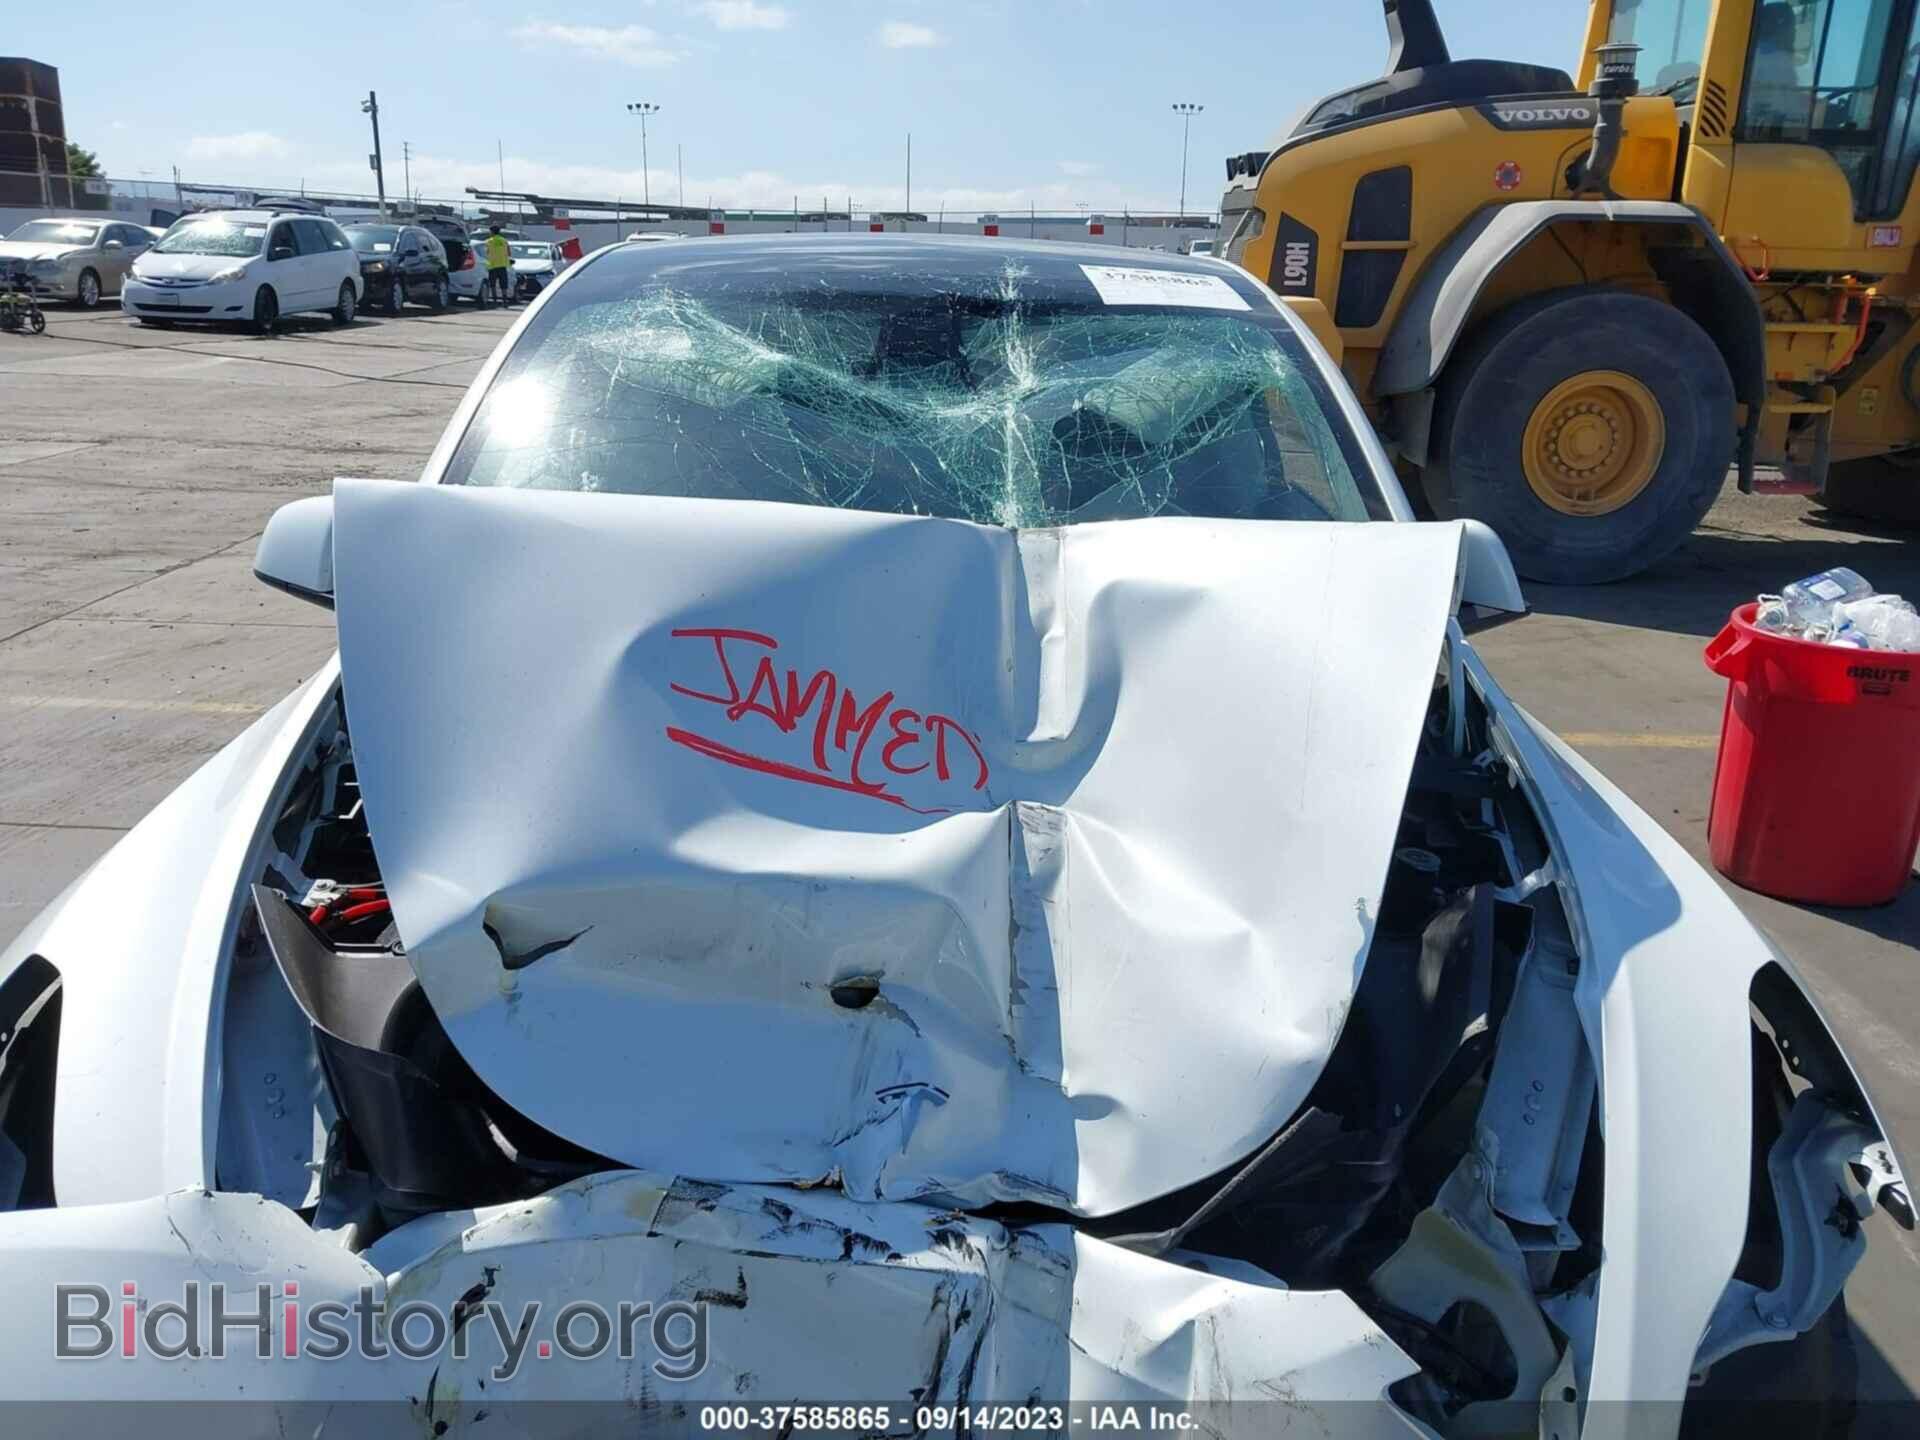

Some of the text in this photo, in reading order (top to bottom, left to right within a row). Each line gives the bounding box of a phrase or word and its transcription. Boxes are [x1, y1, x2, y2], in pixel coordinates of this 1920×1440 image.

[1494, 107, 1590, 122] VOLVO
[1283, 242, 1310, 286] L90H
[1847, 666, 1910, 682] BRUTE
